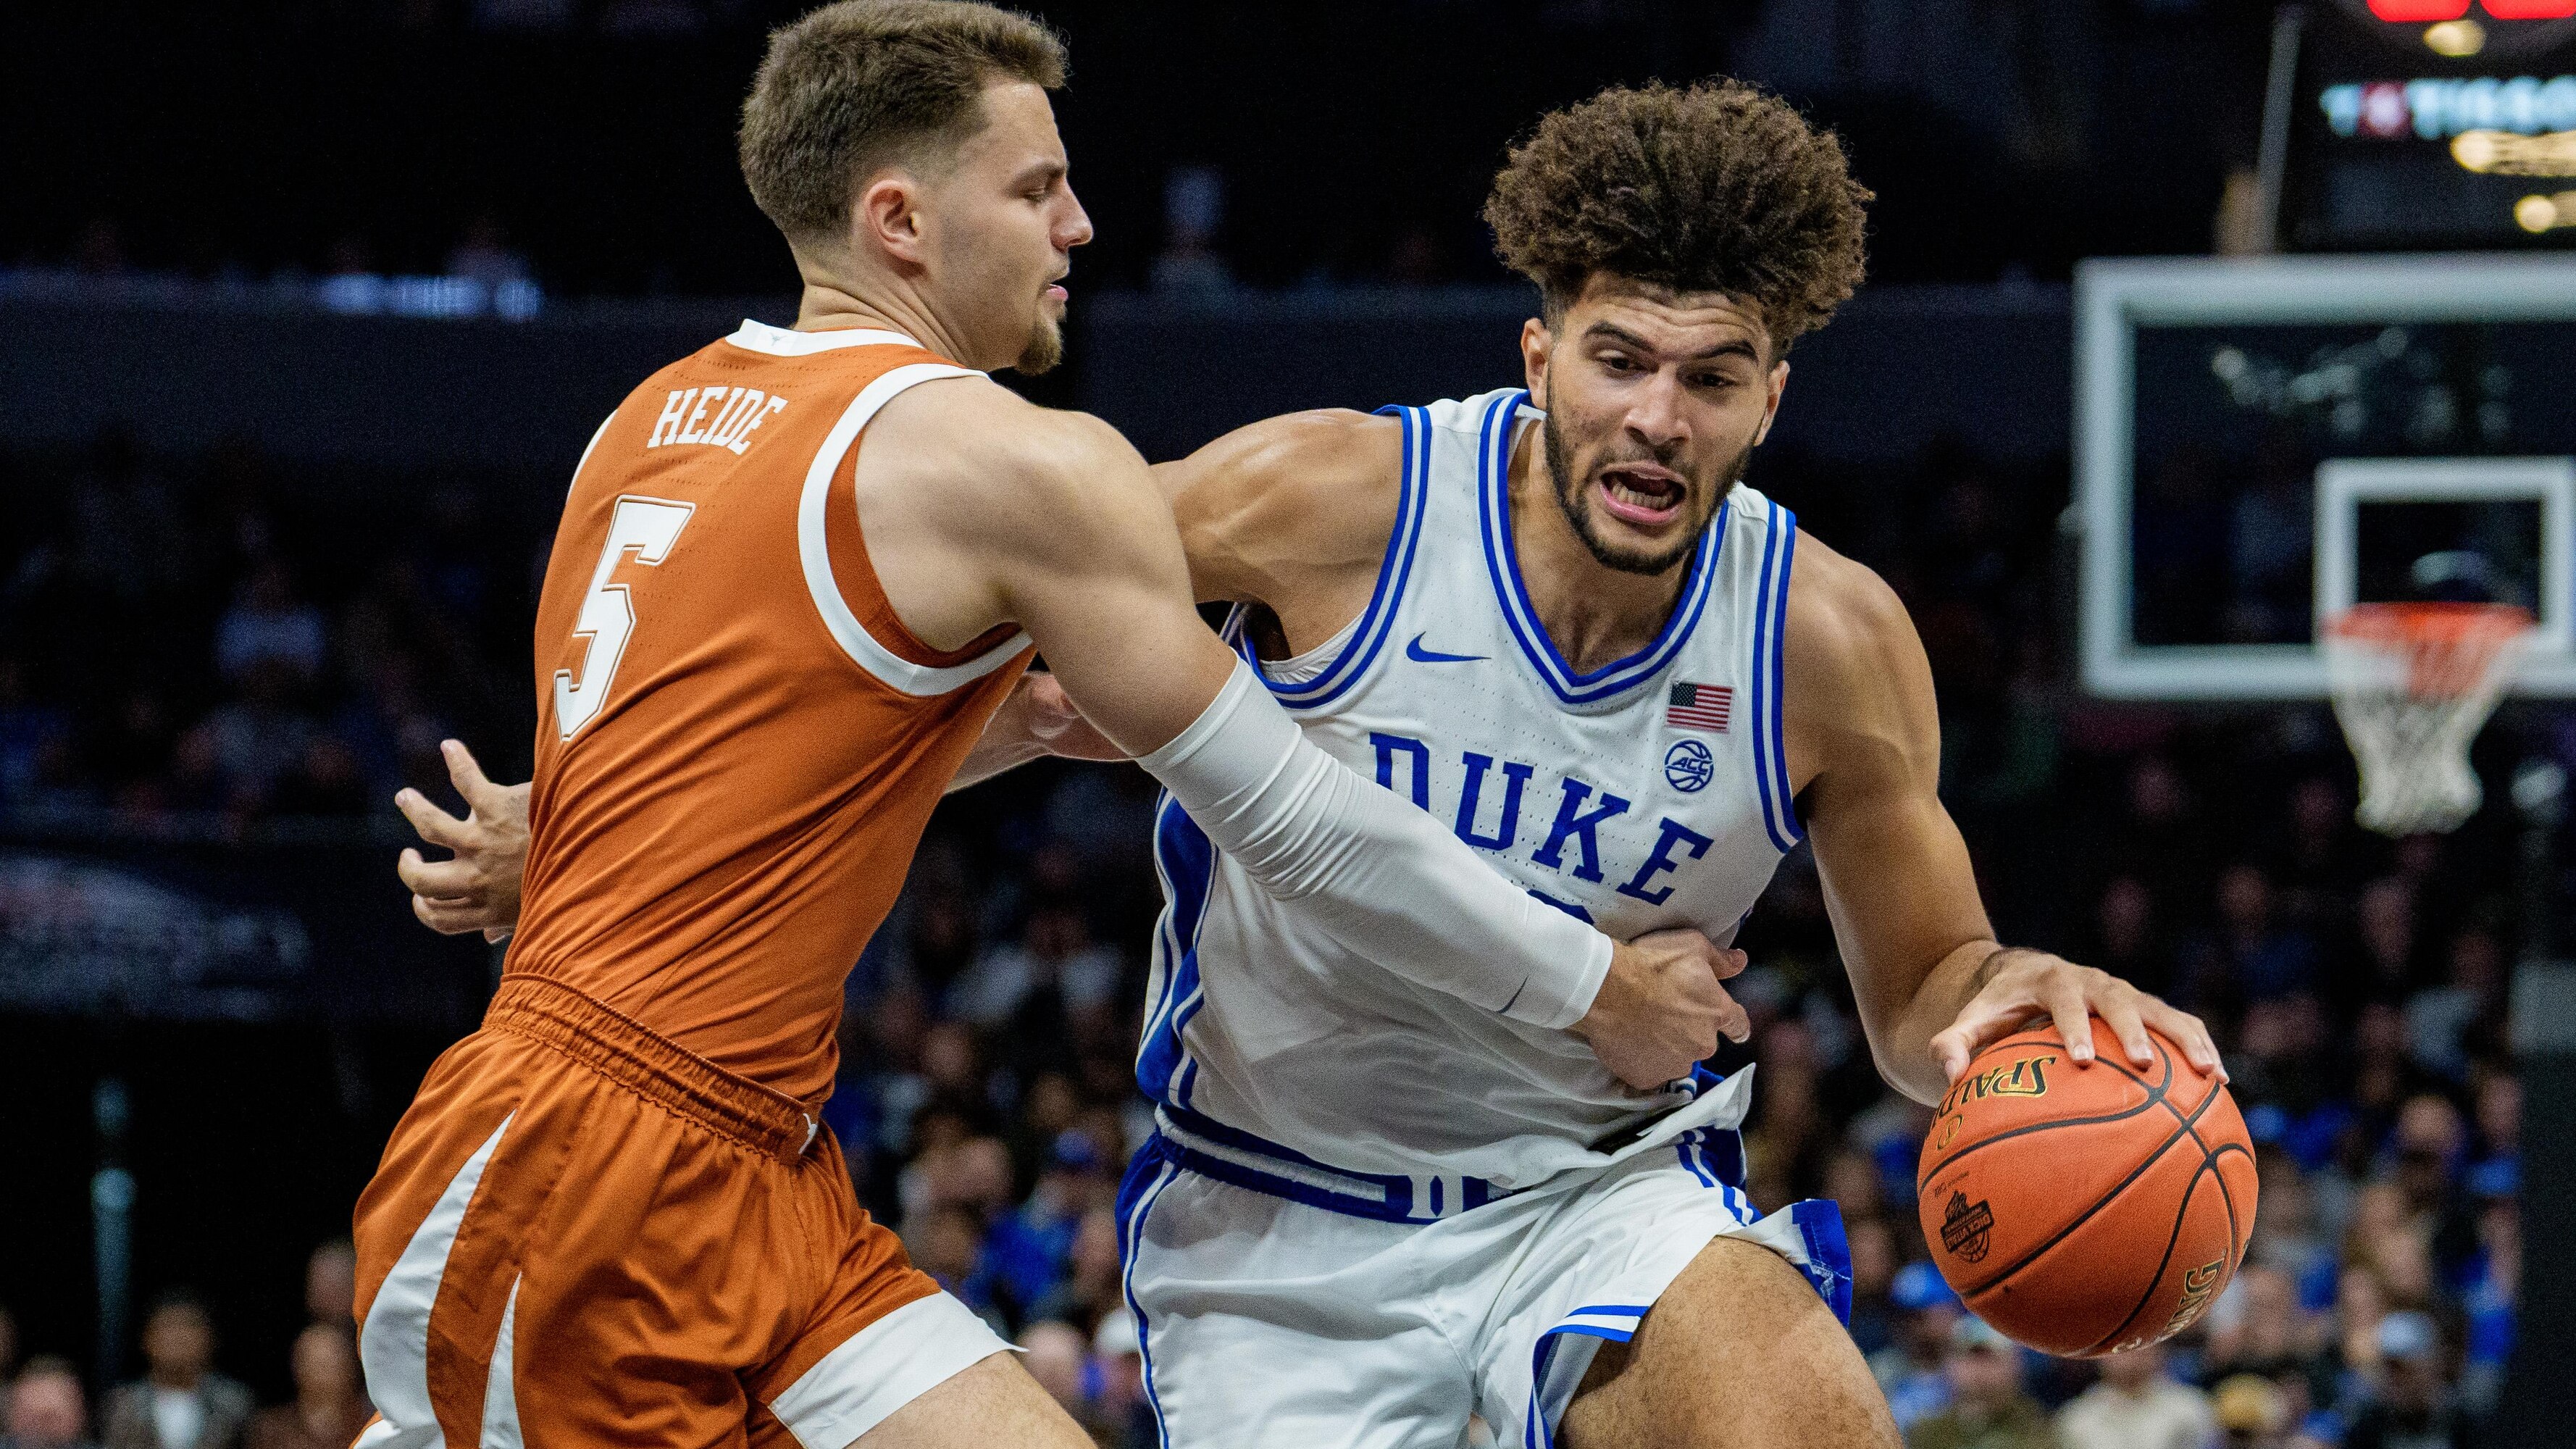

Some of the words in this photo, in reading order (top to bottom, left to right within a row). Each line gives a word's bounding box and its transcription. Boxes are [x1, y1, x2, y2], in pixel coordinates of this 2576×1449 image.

[647, 386, 787, 455] HEIDE
[553, 495, 695, 742] 5
[1668, 756, 1713, 775] ACC
[1369, 732, 1713, 906] DUKE
[1931, 1055, 2057, 1127] SPALD
